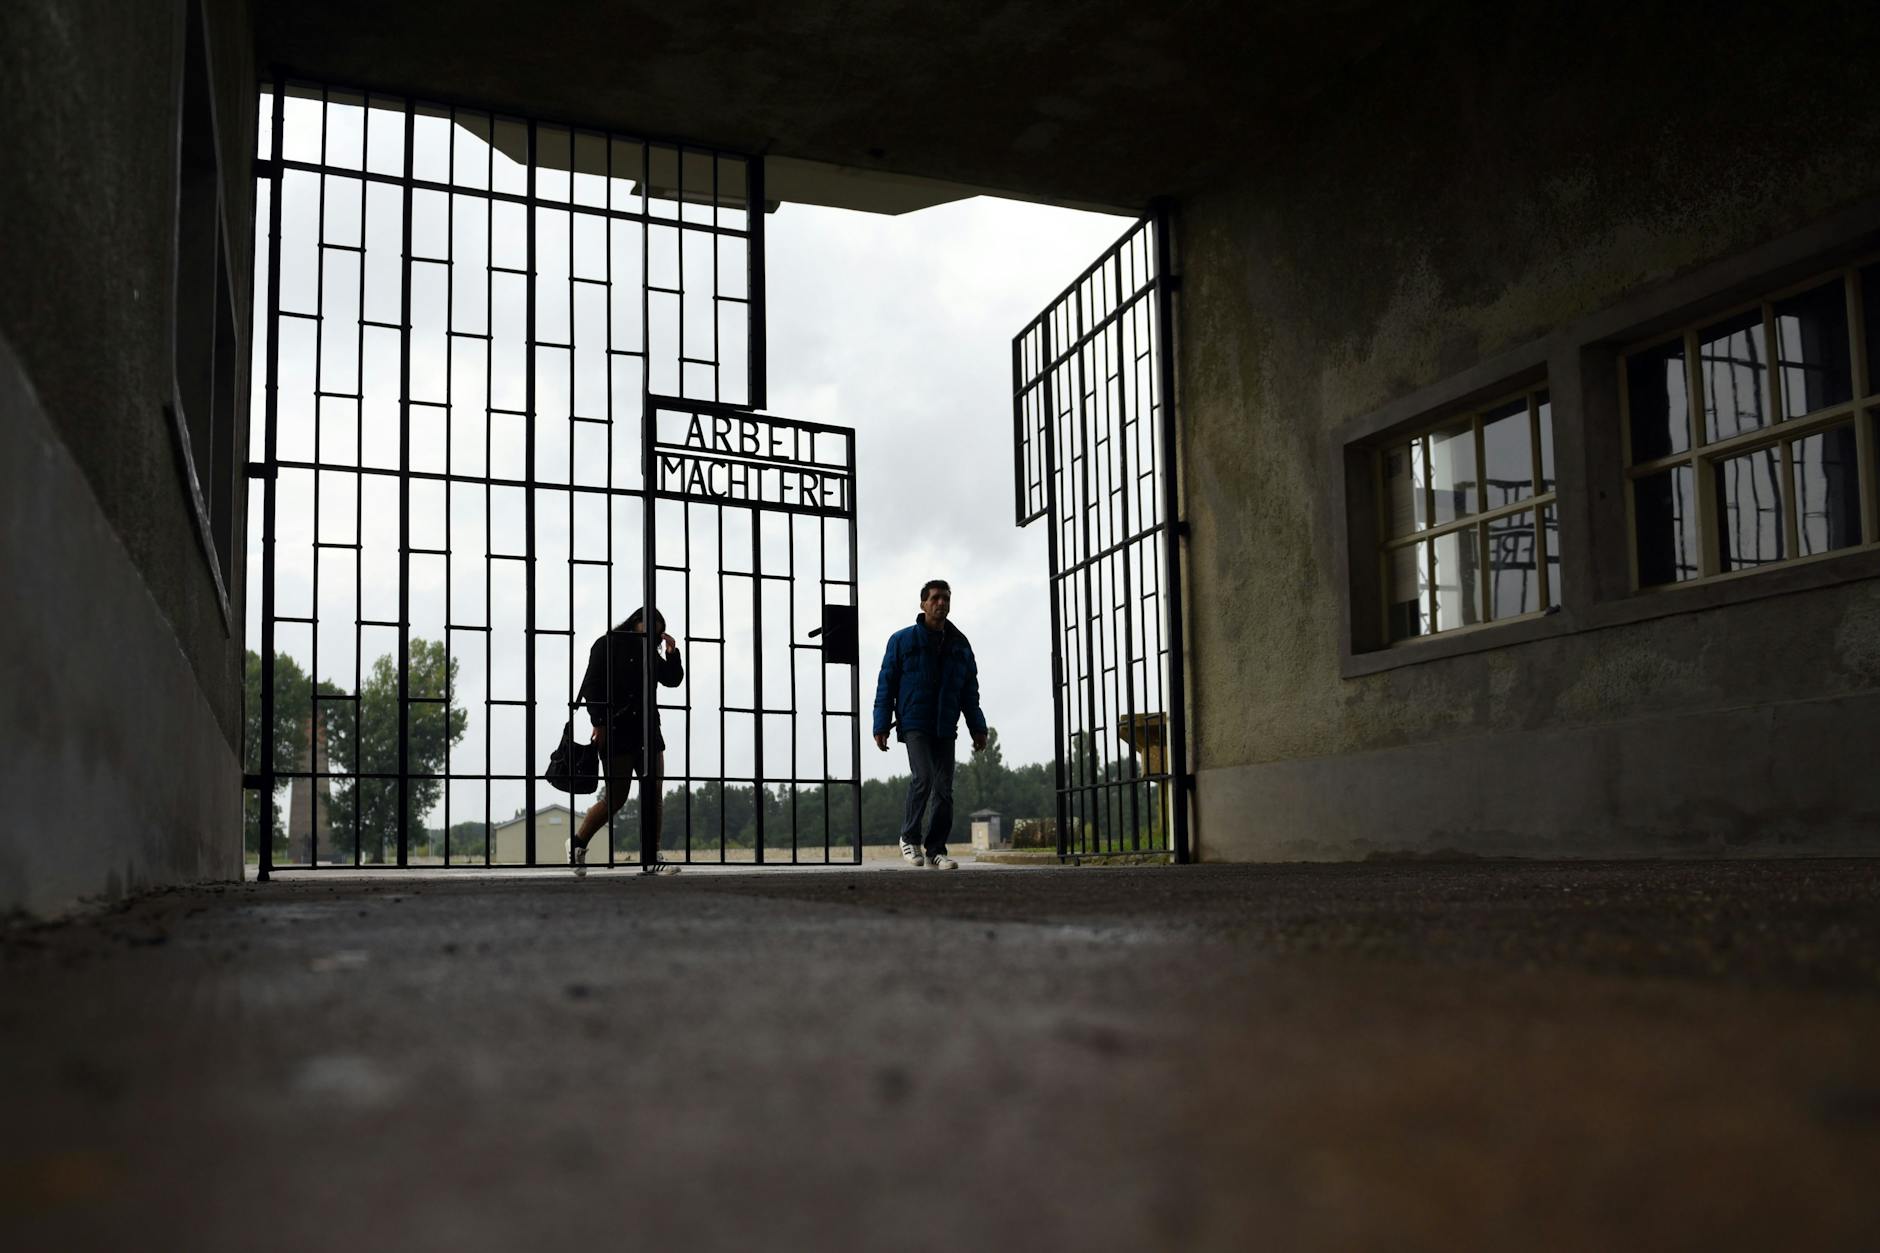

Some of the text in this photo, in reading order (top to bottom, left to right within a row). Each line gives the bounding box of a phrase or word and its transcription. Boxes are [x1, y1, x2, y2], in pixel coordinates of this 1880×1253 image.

[685, 413, 822, 463] ARBEIT
[661, 455, 845, 511] MACHT FREI
